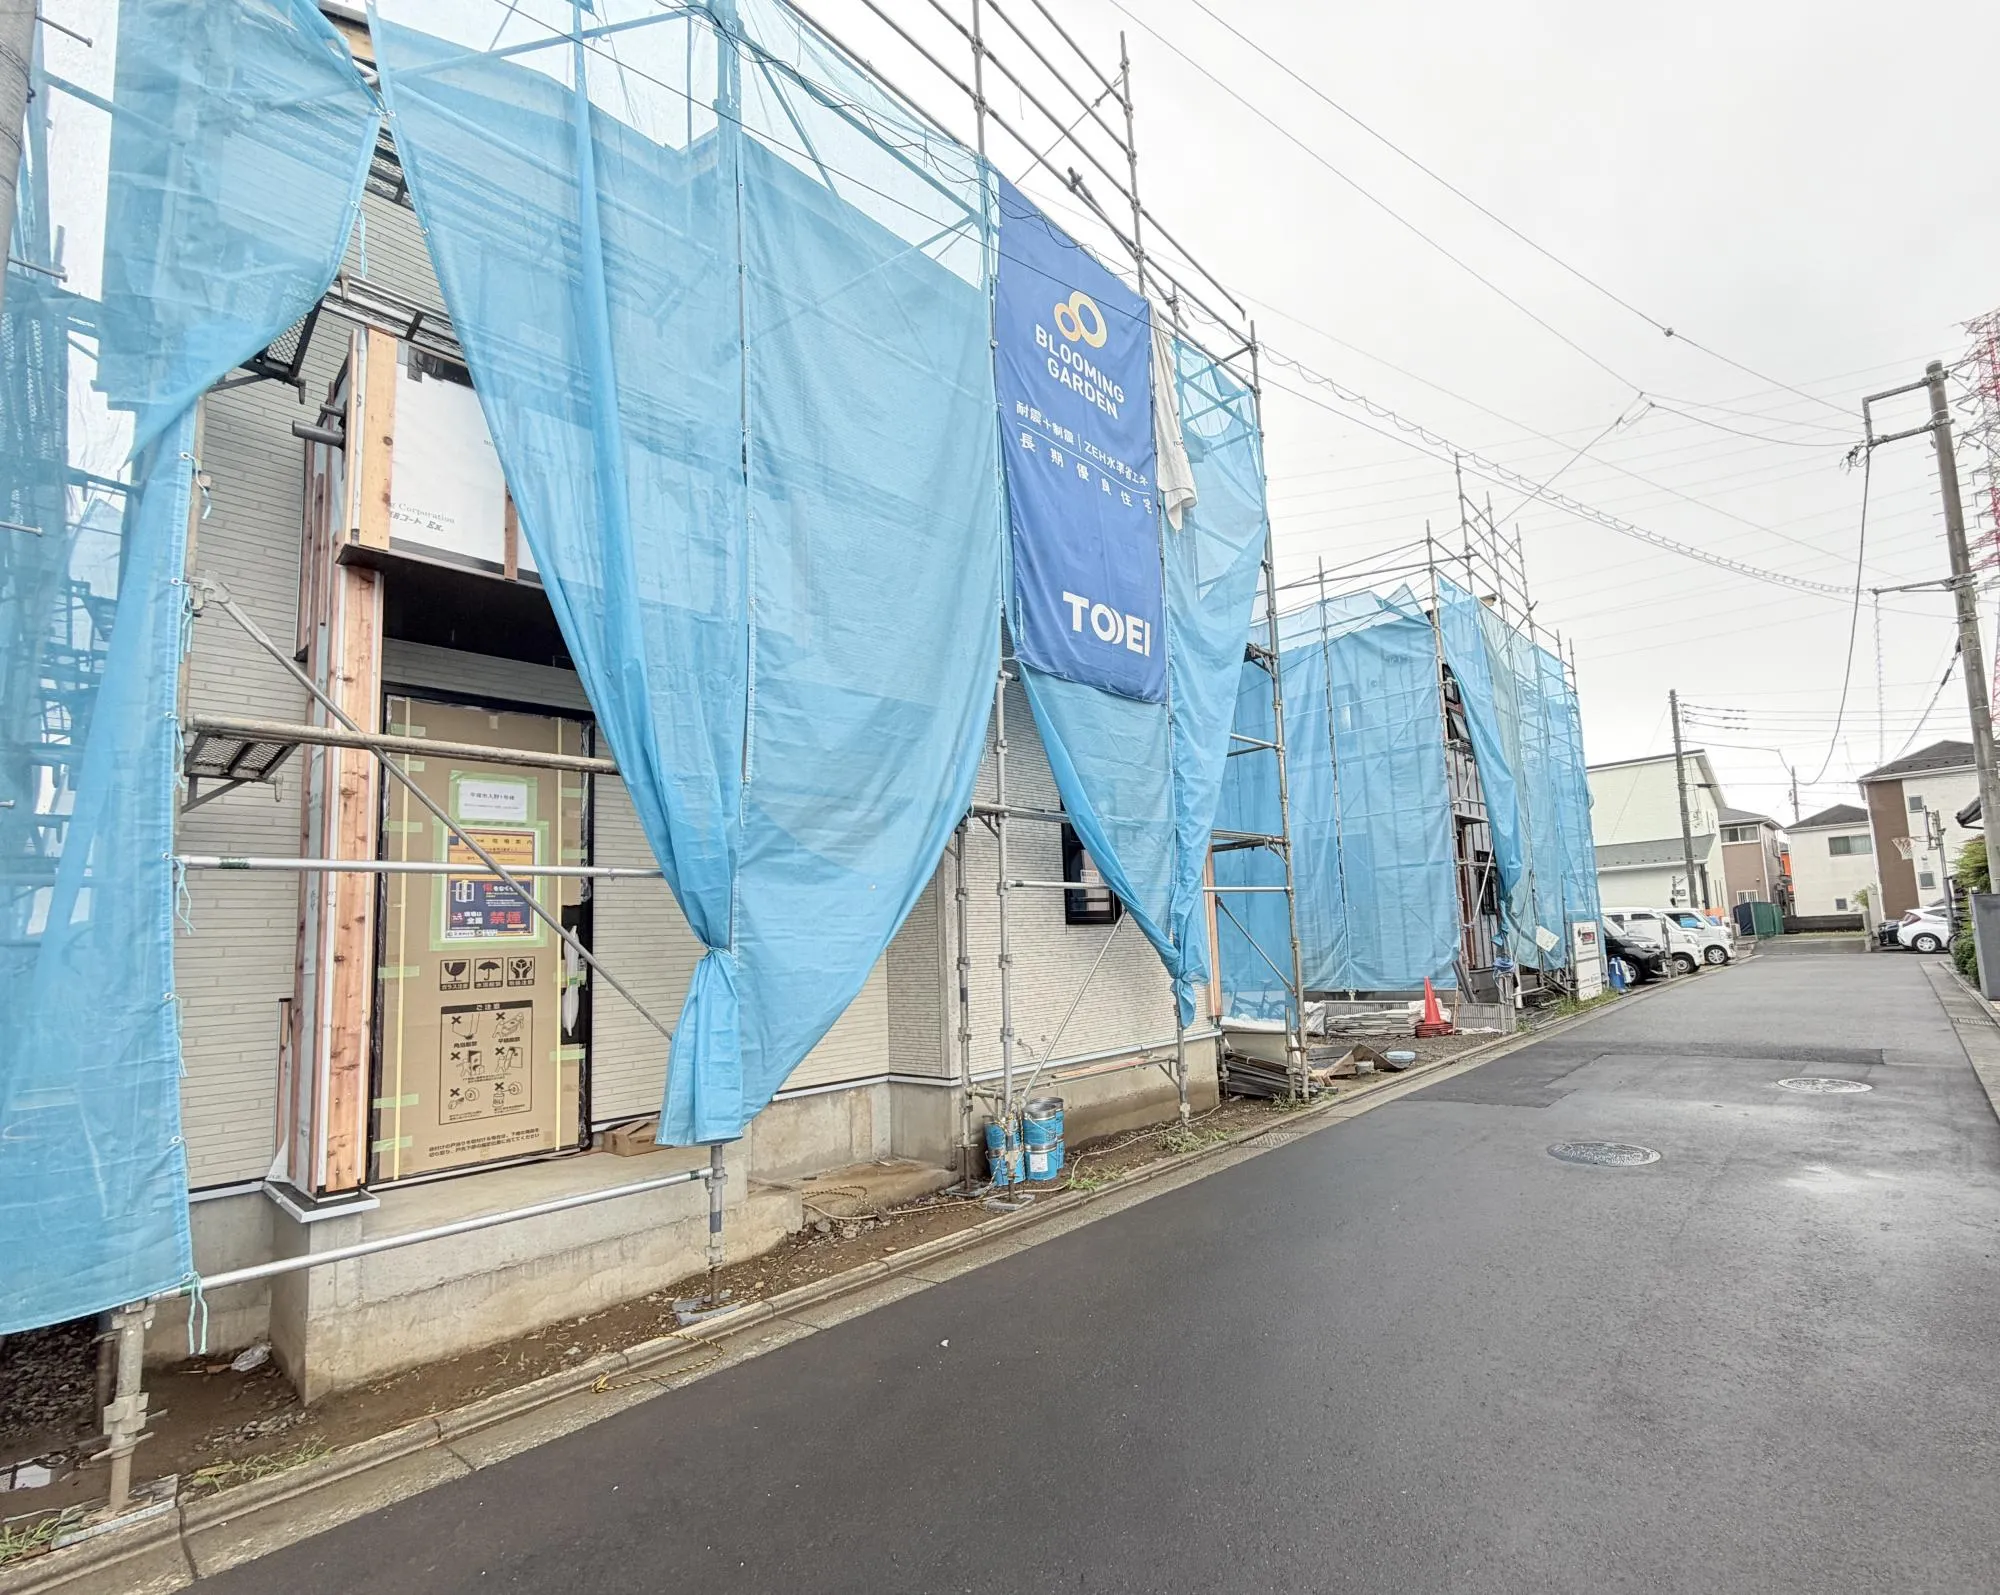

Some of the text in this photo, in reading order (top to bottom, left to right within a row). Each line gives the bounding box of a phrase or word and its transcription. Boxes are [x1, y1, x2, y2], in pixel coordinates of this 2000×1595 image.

[1035, 323, 1125, 404] BLOOMING
[1047, 356, 1119, 420] GARDEN
[1020, 431, 1153, 515] 長期優良住宅
[1062, 590, 1151, 657] TOEI
